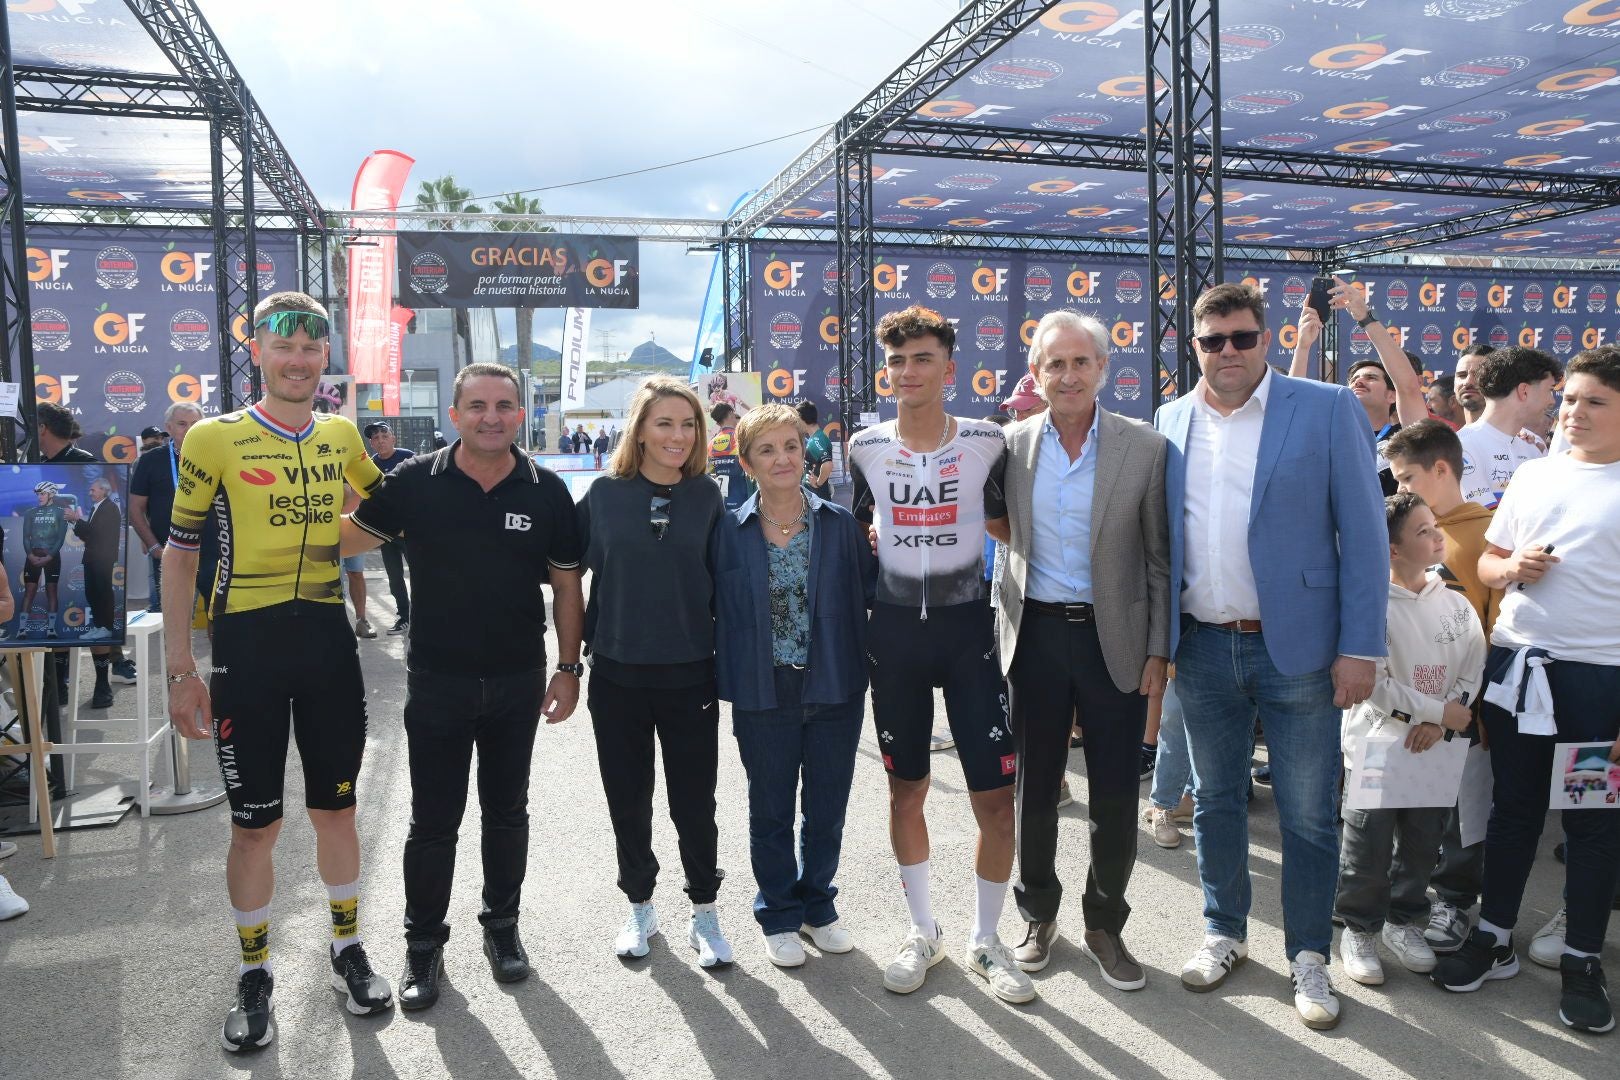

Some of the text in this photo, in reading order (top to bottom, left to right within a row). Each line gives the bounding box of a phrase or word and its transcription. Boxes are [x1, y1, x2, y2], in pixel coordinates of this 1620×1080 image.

[1309, 43, 1432, 72] GF
[916, 101, 1015, 119] GF
[1323, 102, 1428, 121] GF
[1517, 119, 1620, 136] GF
[1334, 140, 1424, 154] GF
[1027, 180, 1105, 193] GF
[26, 248, 70, 281] GF
[161, 252, 212, 283] GF
[471, 247, 567, 267] GRACIAS
[478, 273, 562, 290] por formar parte
[586, 259, 628, 287] GF
[764, 261, 805, 289] GF
[874, 264, 909, 291] GF
[972, 268, 1008, 294] GF
[1067, 271, 1101, 297] GF
[161, 284, 173, 292] LA
[473, 286, 567, 295] de nuestra historia
[1420, 283, 1446, 307] GF
[1488, 285, 1513, 308] GF
[1553, 287, 1578, 308] GF
[94, 312, 146, 345] GF
[1112, 322, 1144, 346] GF
[1453, 327, 1478, 350] GF
[1519, 328, 1544, 349] GF
[1582, 328, 1606, 350] GF
[35, 375, 79, 406] GF
[168, 374, 218, 405] GF
[767, 369, 807, 397] GF
[972, 370, 1008, 396] GF
[233, 435, 261, 447] nimbl
[853, 436, 891, 447] Analog
[182, 457, 213, 487] VISMA
[283, 461, 344, 485] VISMA
[269, 493, 334, 510] lease
[889, 480, 959, 505] UAE
[504, 512, 532, 531] DG
[898, 511, 952, 522] Emirates
[213, 493, 231, 595] Rabobank
[893, 533, 958, 548] XRG
[220, 744, 243, 790] VISMA
